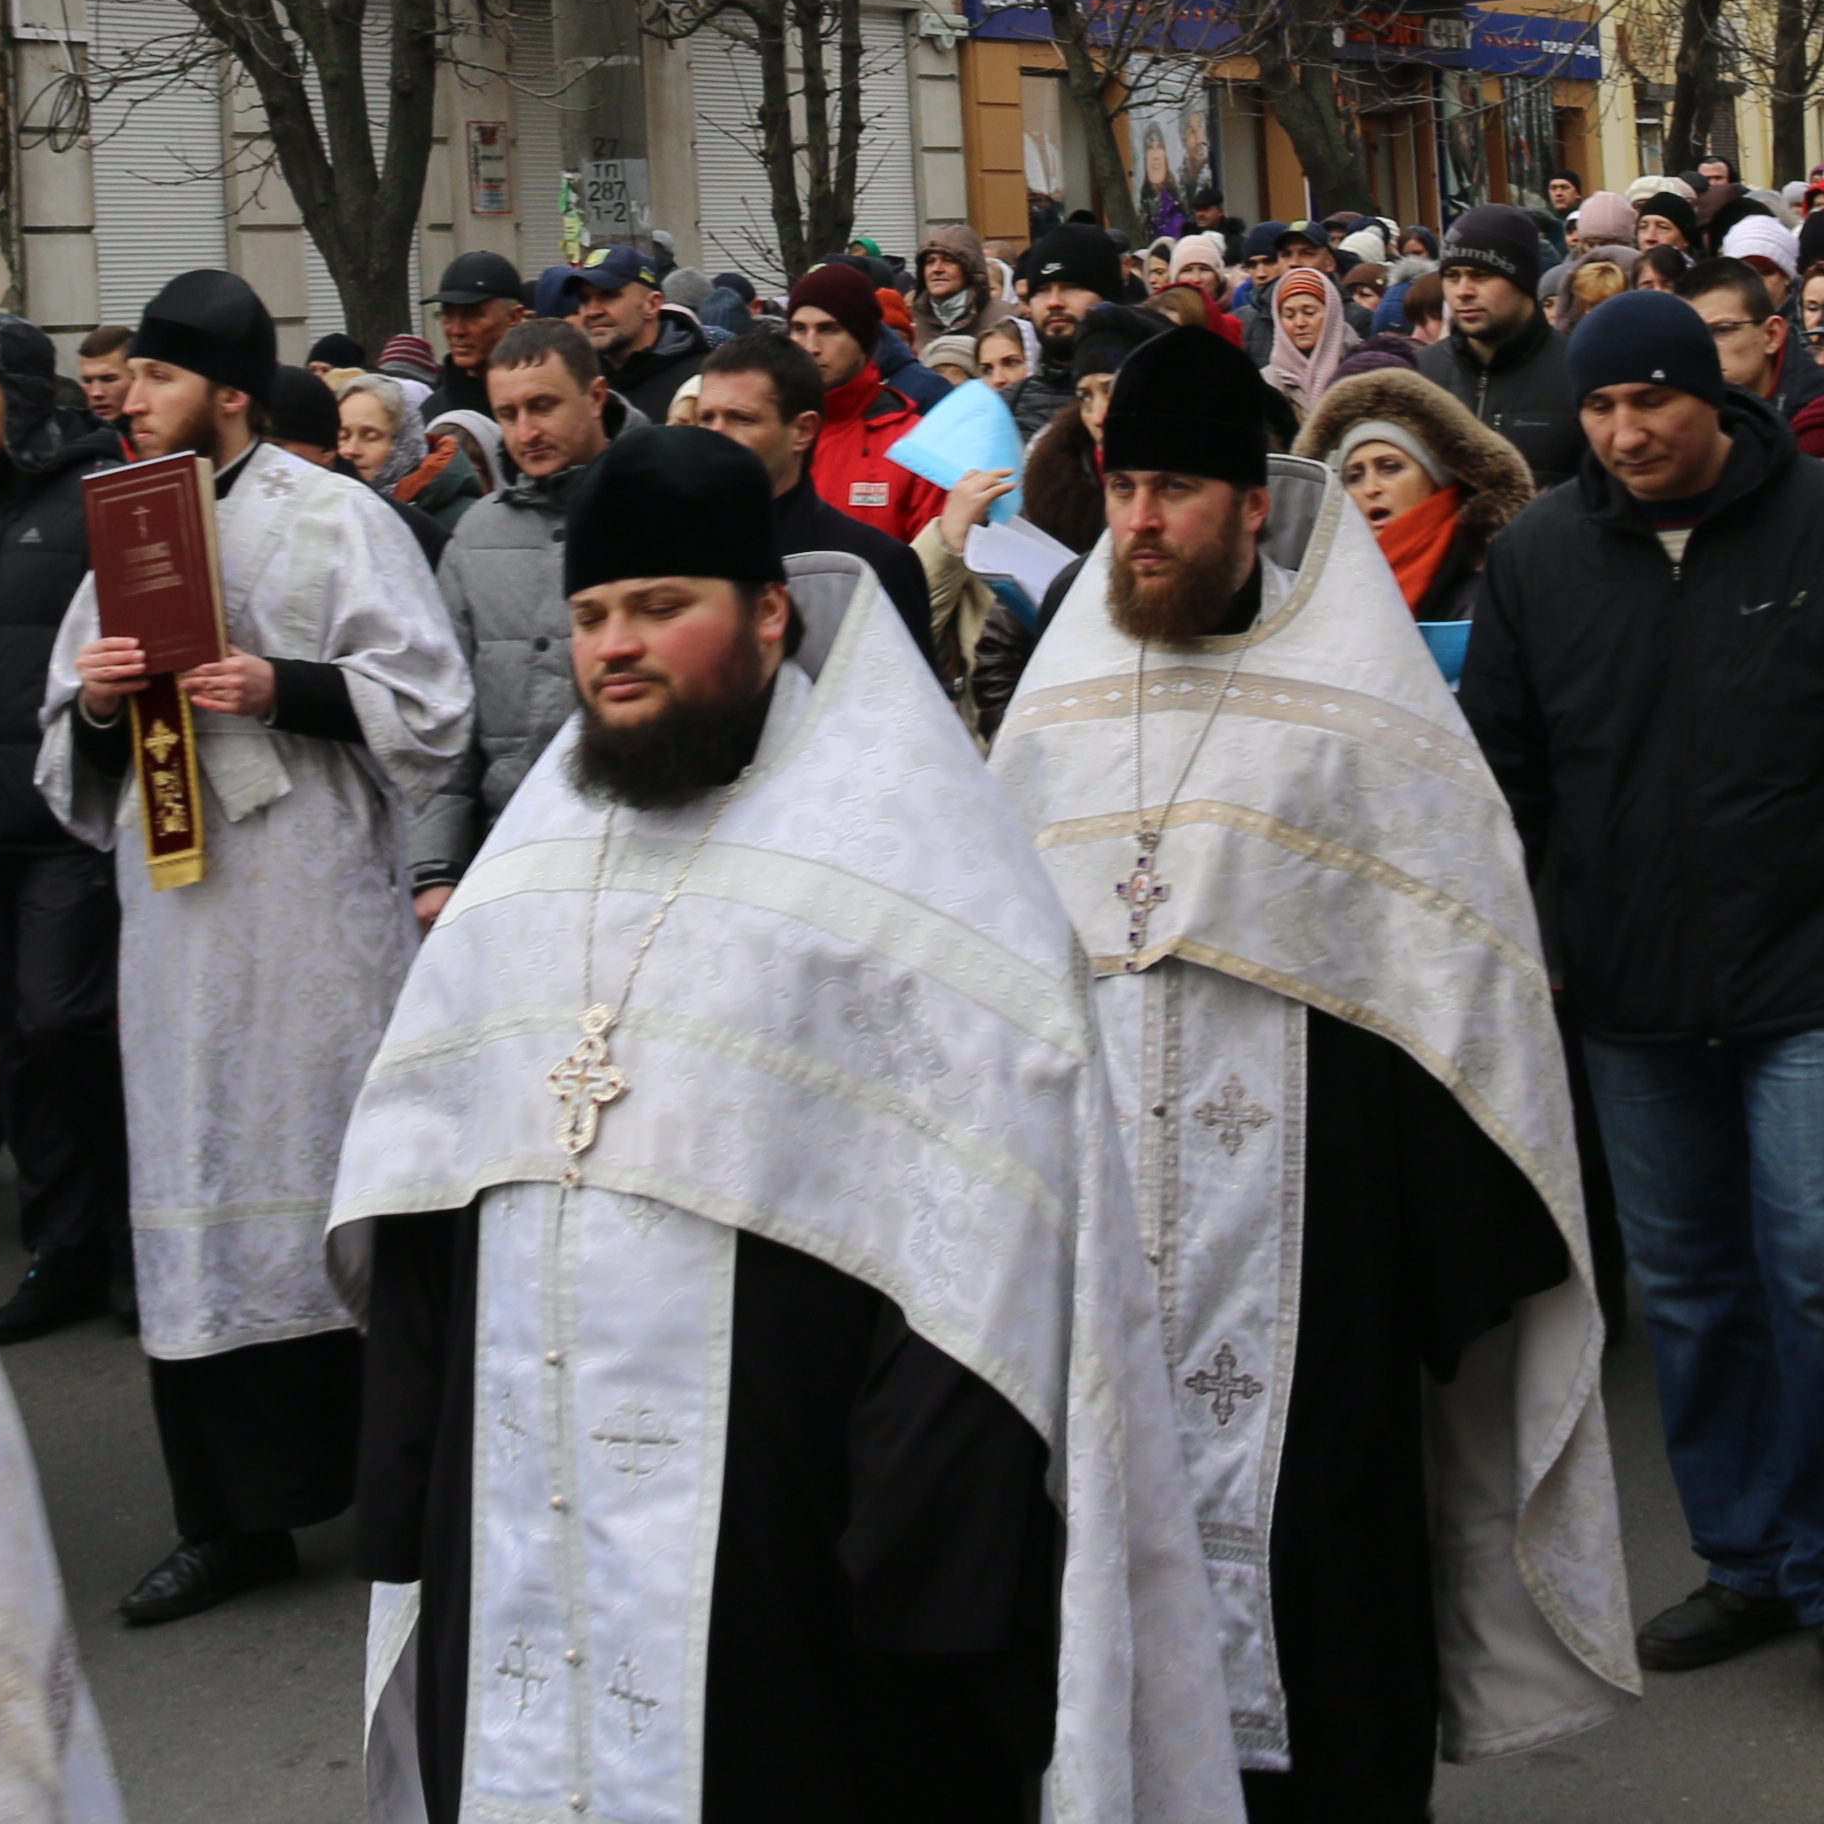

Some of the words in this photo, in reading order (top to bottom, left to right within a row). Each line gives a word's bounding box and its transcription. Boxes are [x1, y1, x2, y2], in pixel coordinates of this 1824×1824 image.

[592, 137, 619, 159] 27
[592, 163, 619, 179] ТП
[587, 180, 626, 203] 287
